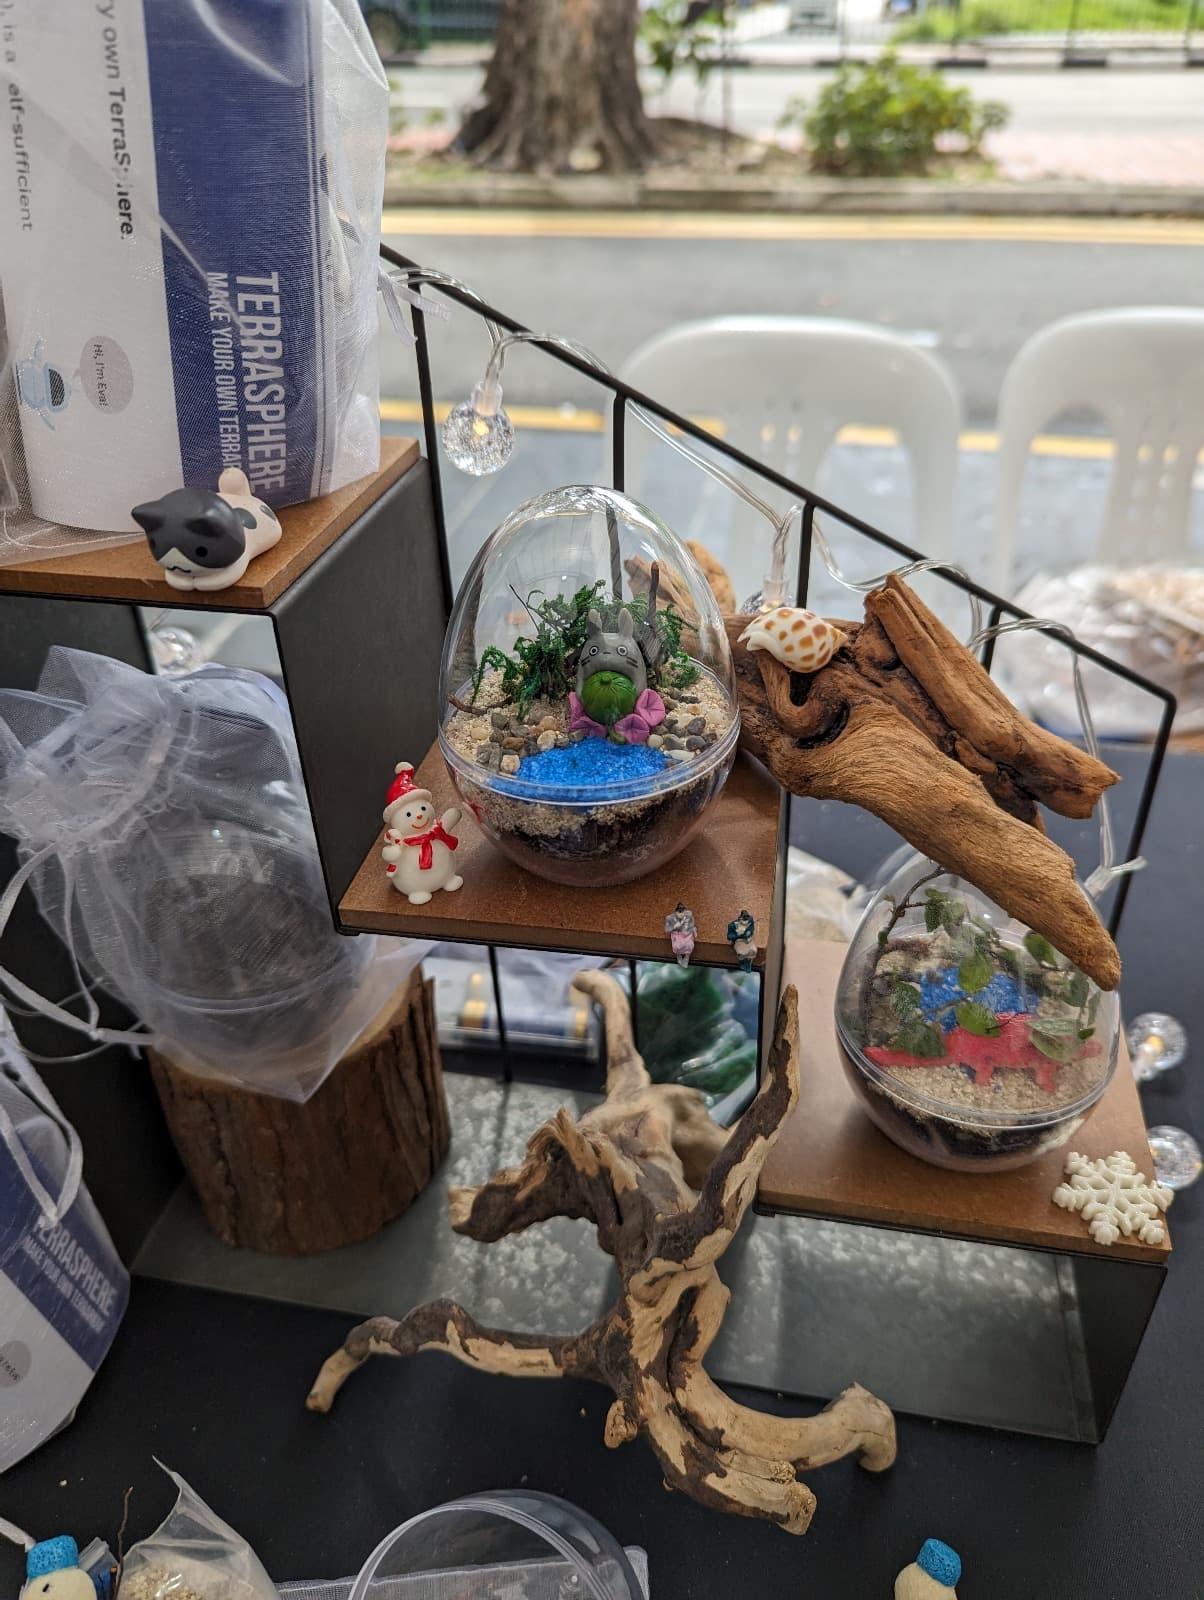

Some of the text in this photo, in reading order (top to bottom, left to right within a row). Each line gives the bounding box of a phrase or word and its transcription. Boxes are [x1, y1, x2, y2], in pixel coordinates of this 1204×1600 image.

[103, 27, 121, 79] own
[8, 80, 33, 231] elf-sufficient
[207, 272, 232, 323] MAKE
[93, 344, 104, 359] Hi,
[211, 327, 235, 371] YOUR
[215, 375, 239, 411] OWN
[236, 272, 287, 493] TERRASPHERE
